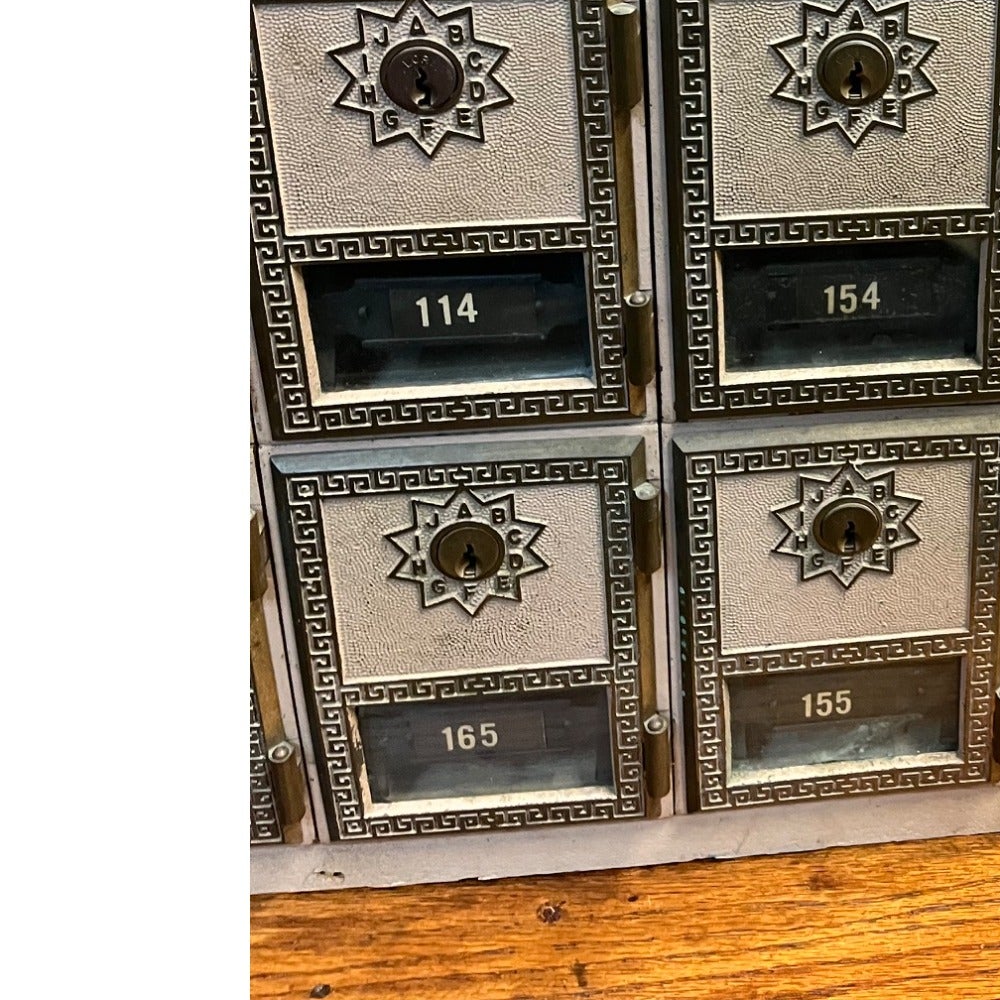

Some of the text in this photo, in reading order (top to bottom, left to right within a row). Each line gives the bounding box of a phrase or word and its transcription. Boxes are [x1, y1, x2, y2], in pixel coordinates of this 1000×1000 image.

[374, 24, 389, 47] J
[410, 15, 427, 36] A
[448, 24, 463, 46] B
[467, 51, 482, 70] C
[360, 84, 377, 103] H
[470, 80, 485, 101] D
[382, 110, 398, 128] G
[456, 106, 472, 126] E
[420, 118, 435, 138] F
[823, 281, 881, 314] 154
[415, 292, 479, 327] 114
[457, 502, 472, 519] A
[492, 507, 506, 524] B
[507, 528, 522, 544] C
[509, 551, 523, 569] D
[801, 689, 852, 718] 155
[441, 722, 498, 751] 165
